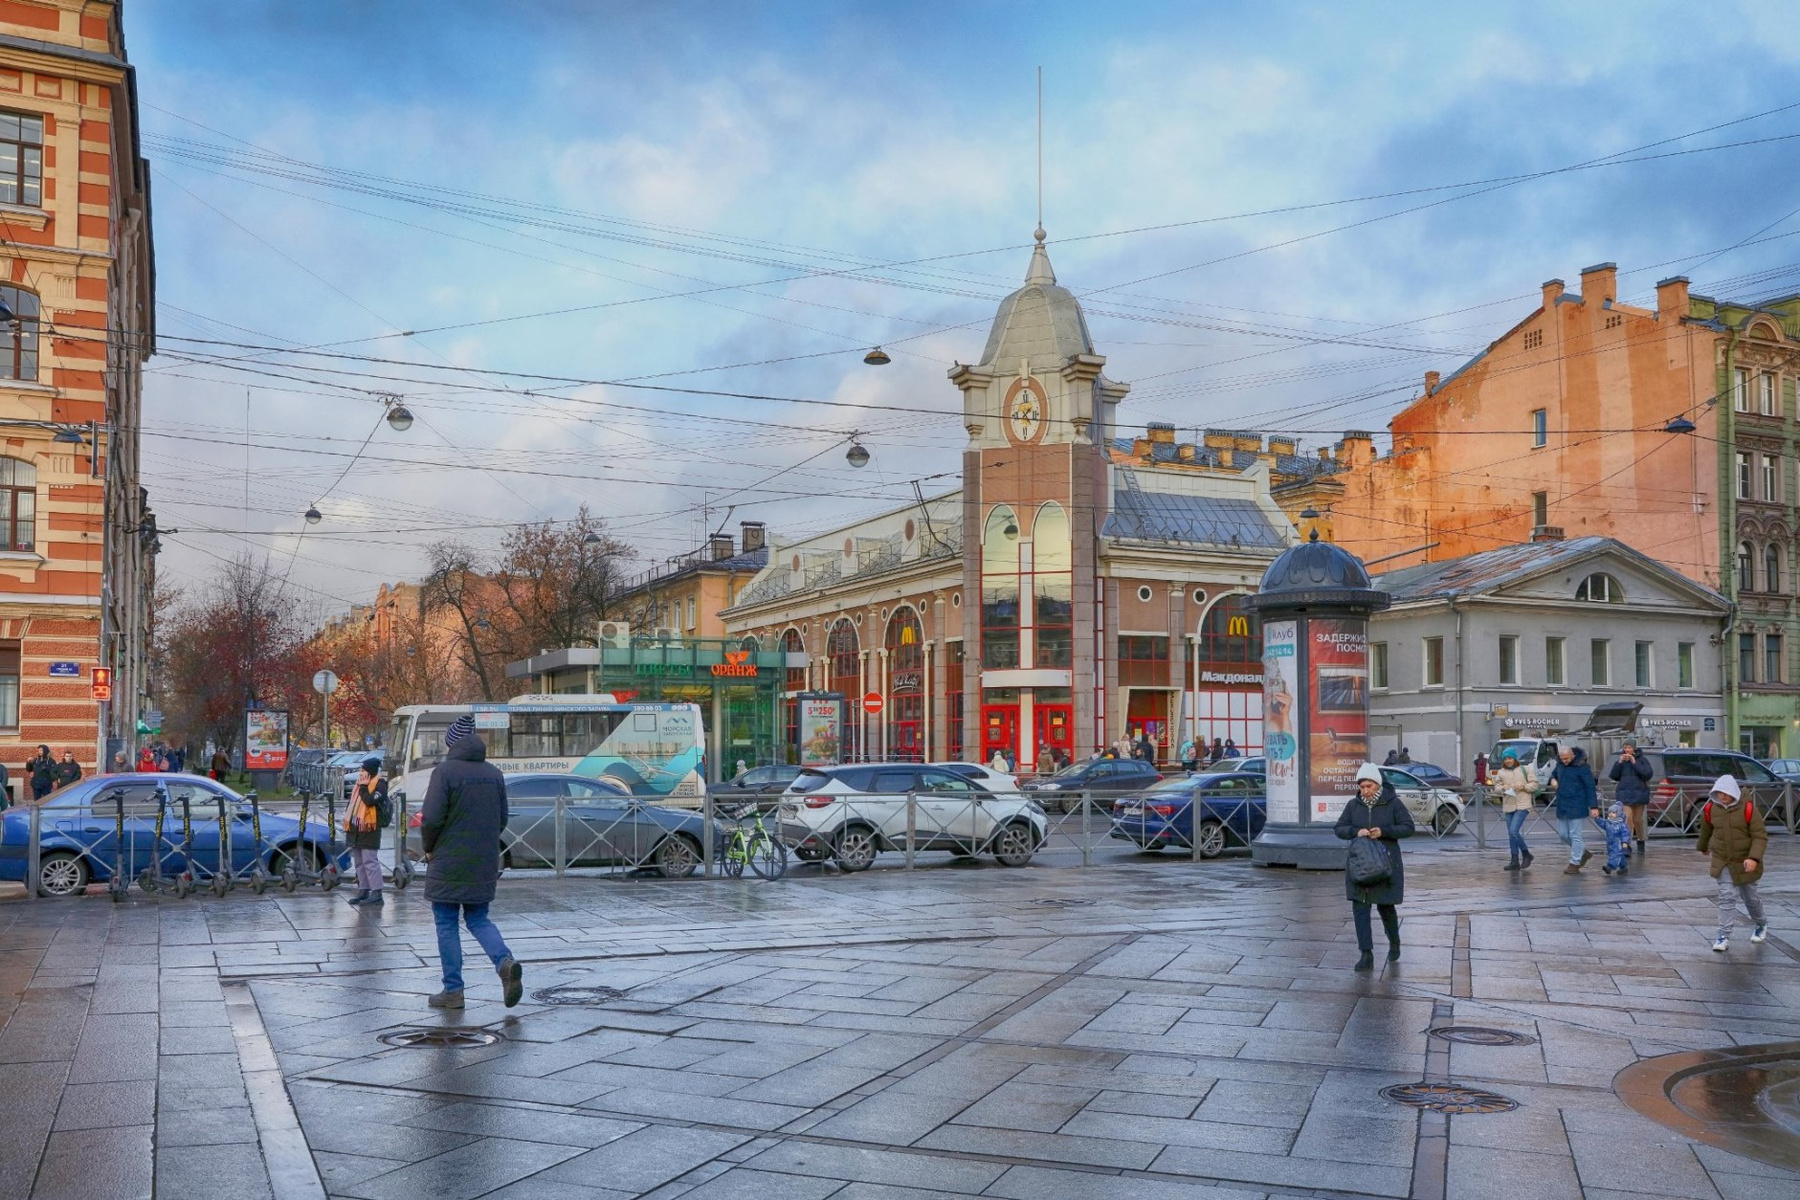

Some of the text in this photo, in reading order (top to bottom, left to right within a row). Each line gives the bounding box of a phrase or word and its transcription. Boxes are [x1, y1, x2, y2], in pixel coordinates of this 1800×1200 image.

[636, 663, 693, 677] ЦВЕТЫ
[711, 663, 758, 677] ОРАНЖ
[495, 761, 569, 771] ОВЫЕ КВАРТИРЫ
[1317, 775, 1342, 783] ПЕРЕД
